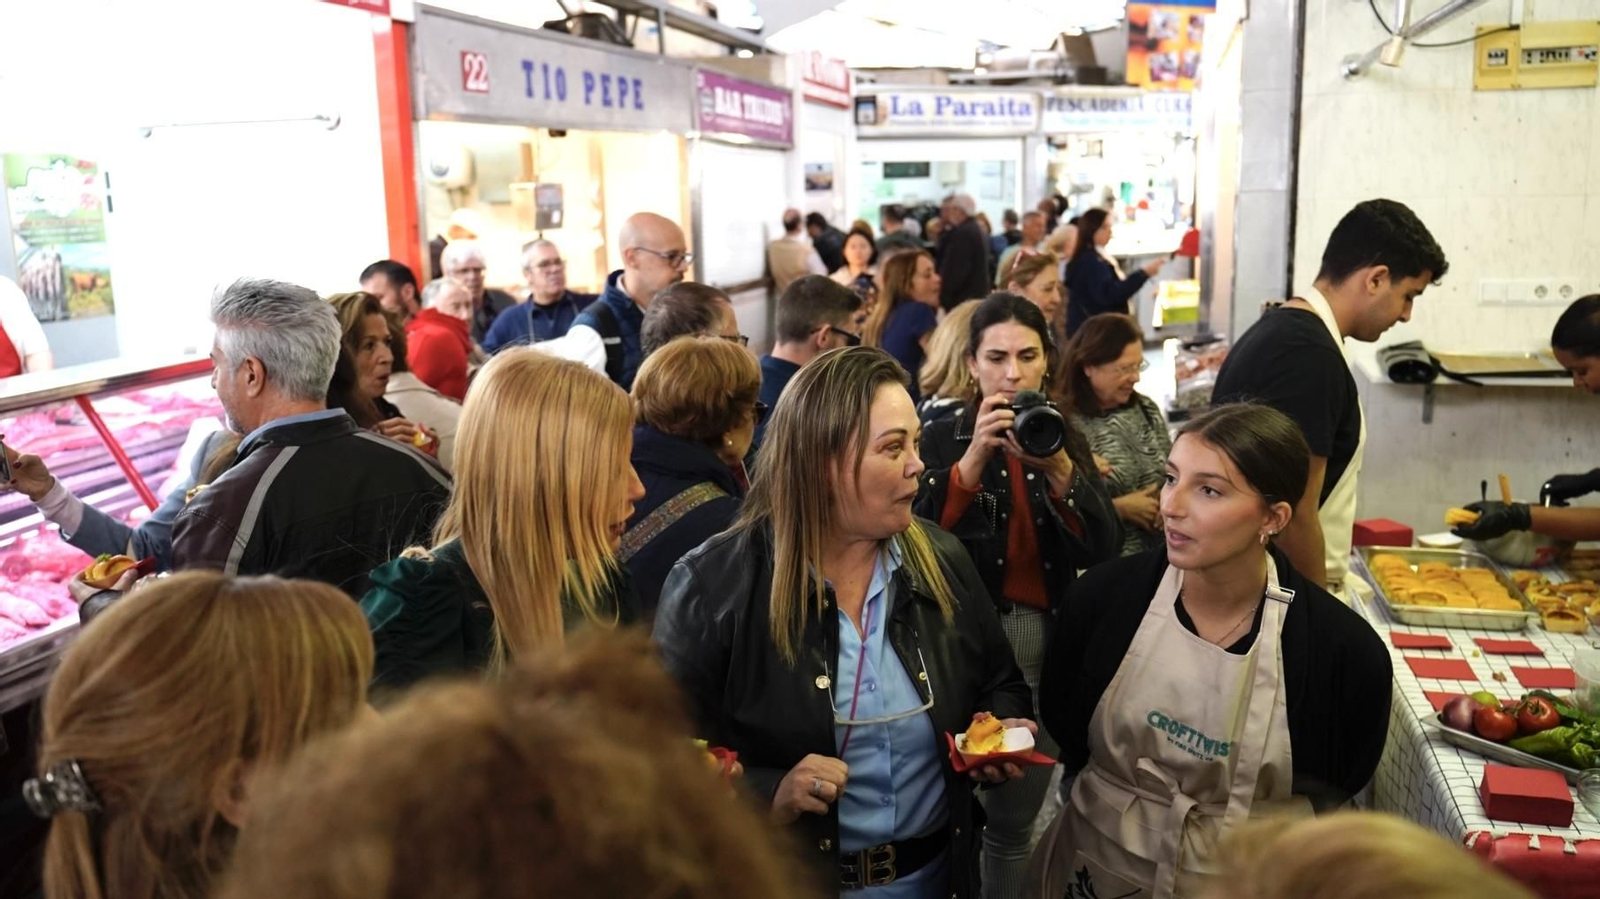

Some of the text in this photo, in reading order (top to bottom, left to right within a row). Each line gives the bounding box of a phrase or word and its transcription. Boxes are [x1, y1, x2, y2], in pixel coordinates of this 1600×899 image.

[464, 53, 489, 91] 22
[521, 59, 645, 110] TIO PEPE
[890, 95, 1032, 117] La Paraita
[1147, 710, 1233, 757] CROFTTWIS
